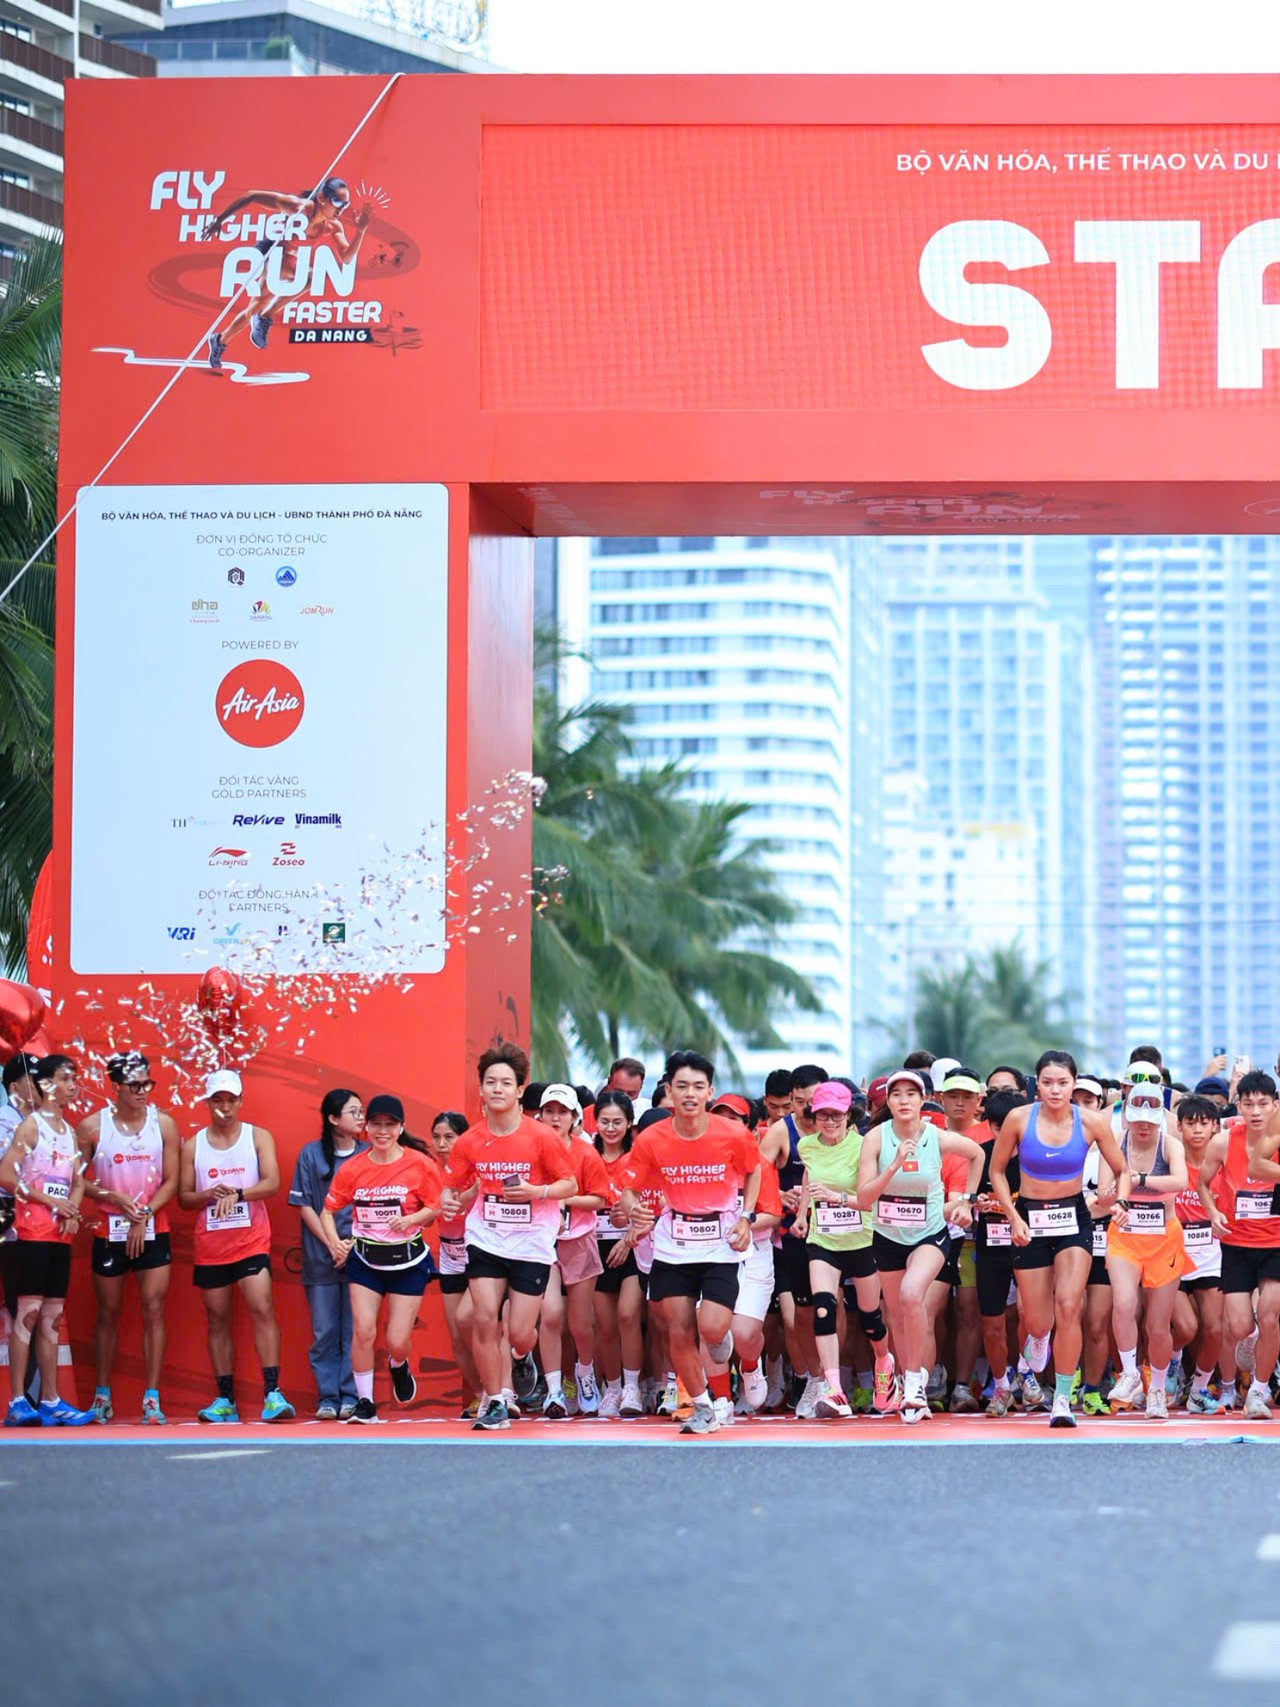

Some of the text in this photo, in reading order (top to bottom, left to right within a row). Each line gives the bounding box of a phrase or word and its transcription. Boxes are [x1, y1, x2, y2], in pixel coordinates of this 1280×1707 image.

[897, 149, 931, 175] BỘ
[939, 149, 989, 171] VĂN
[997, 149, 1058, 173] HÓA,
[1064, 146, 1111, 171] THỂ
[1119, 153, 1186, 171] THAO
[1193, 148, 1226, 171] VÀ
[1233, 153, 1269, 171] DU
[150, 170, 225, 210] FLY
[219, 245, 358, 298] RUN
[282, 300, 383, 324] FASTER
[294, 330, 368, 342] DA NANG
[191, 511, 218, 520] THAO
[236, 511, 251, 519] DU
[284, 511, 313, 519] UBND
[217, 547, 306, 558] CO-ORGANIZER
[221, 640, 299, 651] POWERED BY
[221, 686, 300, 722] AirAsia
[211, 788, 307, 800] GOLD PARTNERS
[295, 812, 343, 825] Vinamilk
[489, 1161, 531, 1172] HIGHER
[680, 1163, 726, 1175] HIGHER
[686, 1173, 725, 1185] FASTER
[500, 1208, 528, 1216] 10808
[832, 1210, 856, 1219] 10287
[896, 1206, 922, 1214] 10670
[1047, 1211, 1073, 1221] 10628
[689, 1225, 716, 1233] 10802
